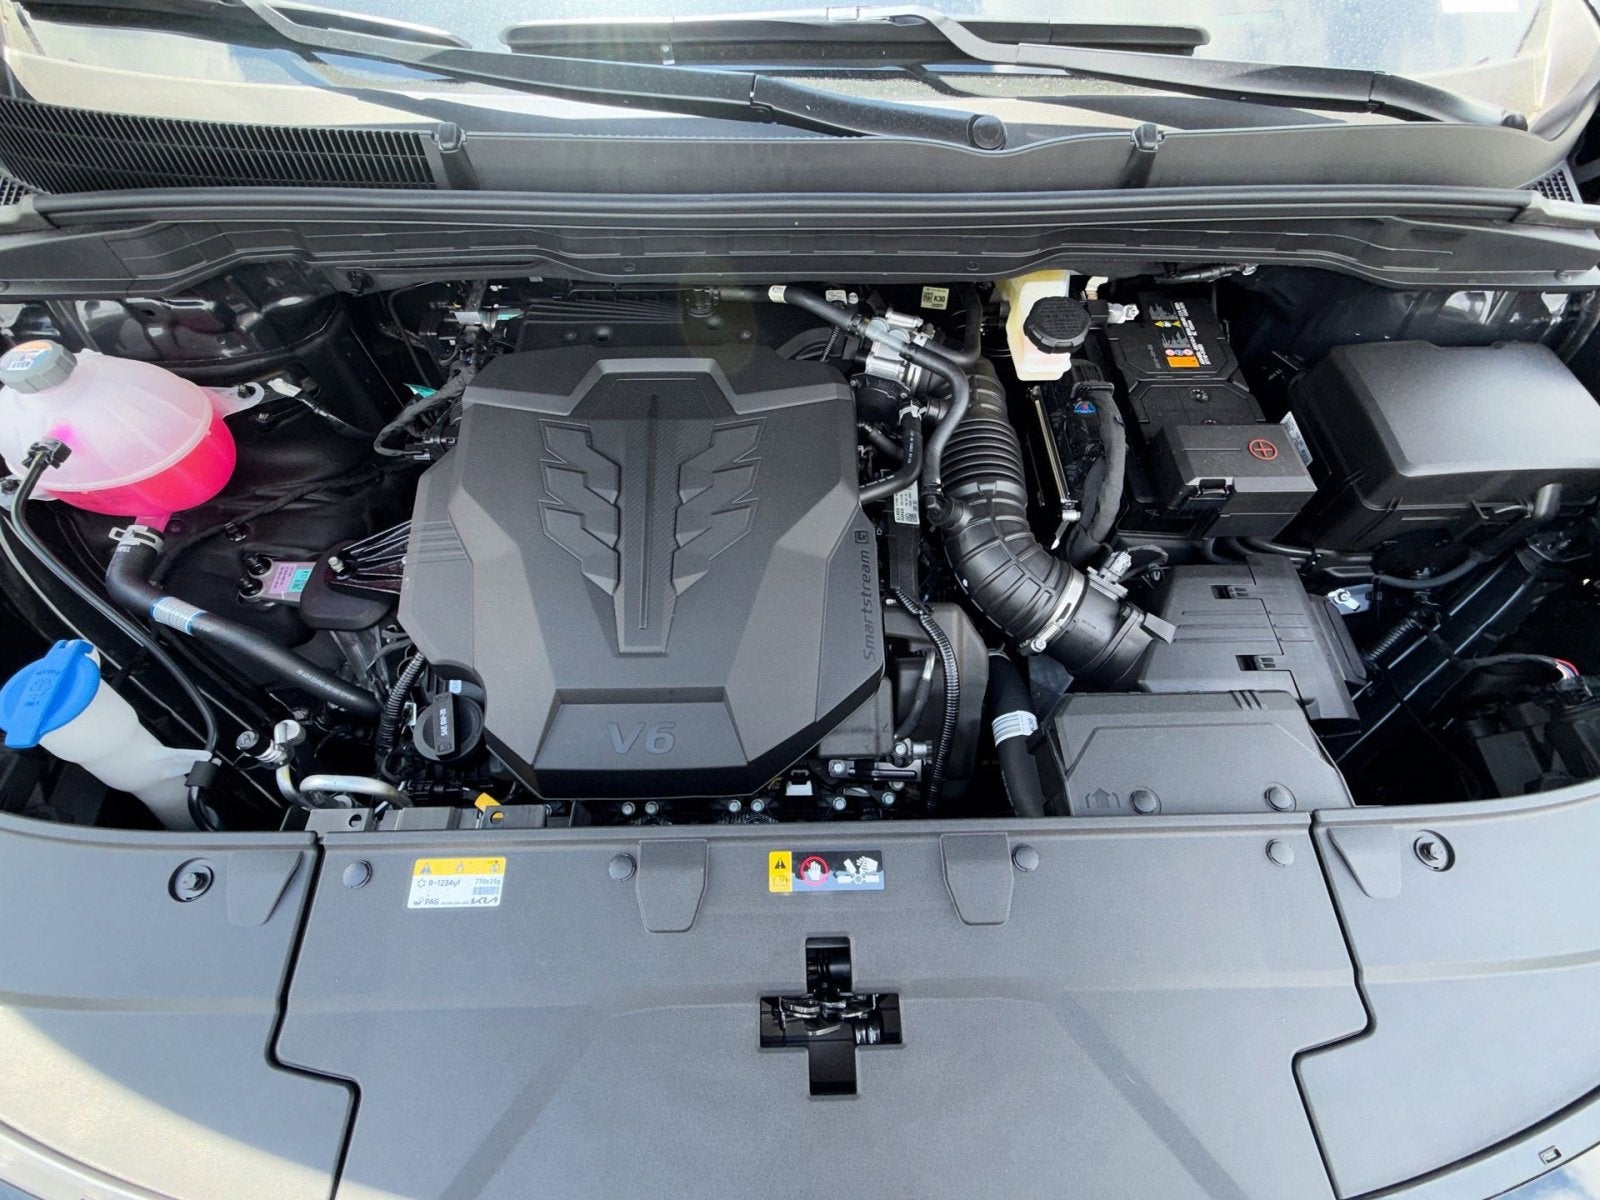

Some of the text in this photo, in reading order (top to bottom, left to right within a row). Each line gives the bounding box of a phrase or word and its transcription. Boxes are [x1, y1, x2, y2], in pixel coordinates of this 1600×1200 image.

[860, 550, 876, 661] Smartstream
[608, 721, 677, 755] V6
[428, 878, 461, 888] R-1234yf
